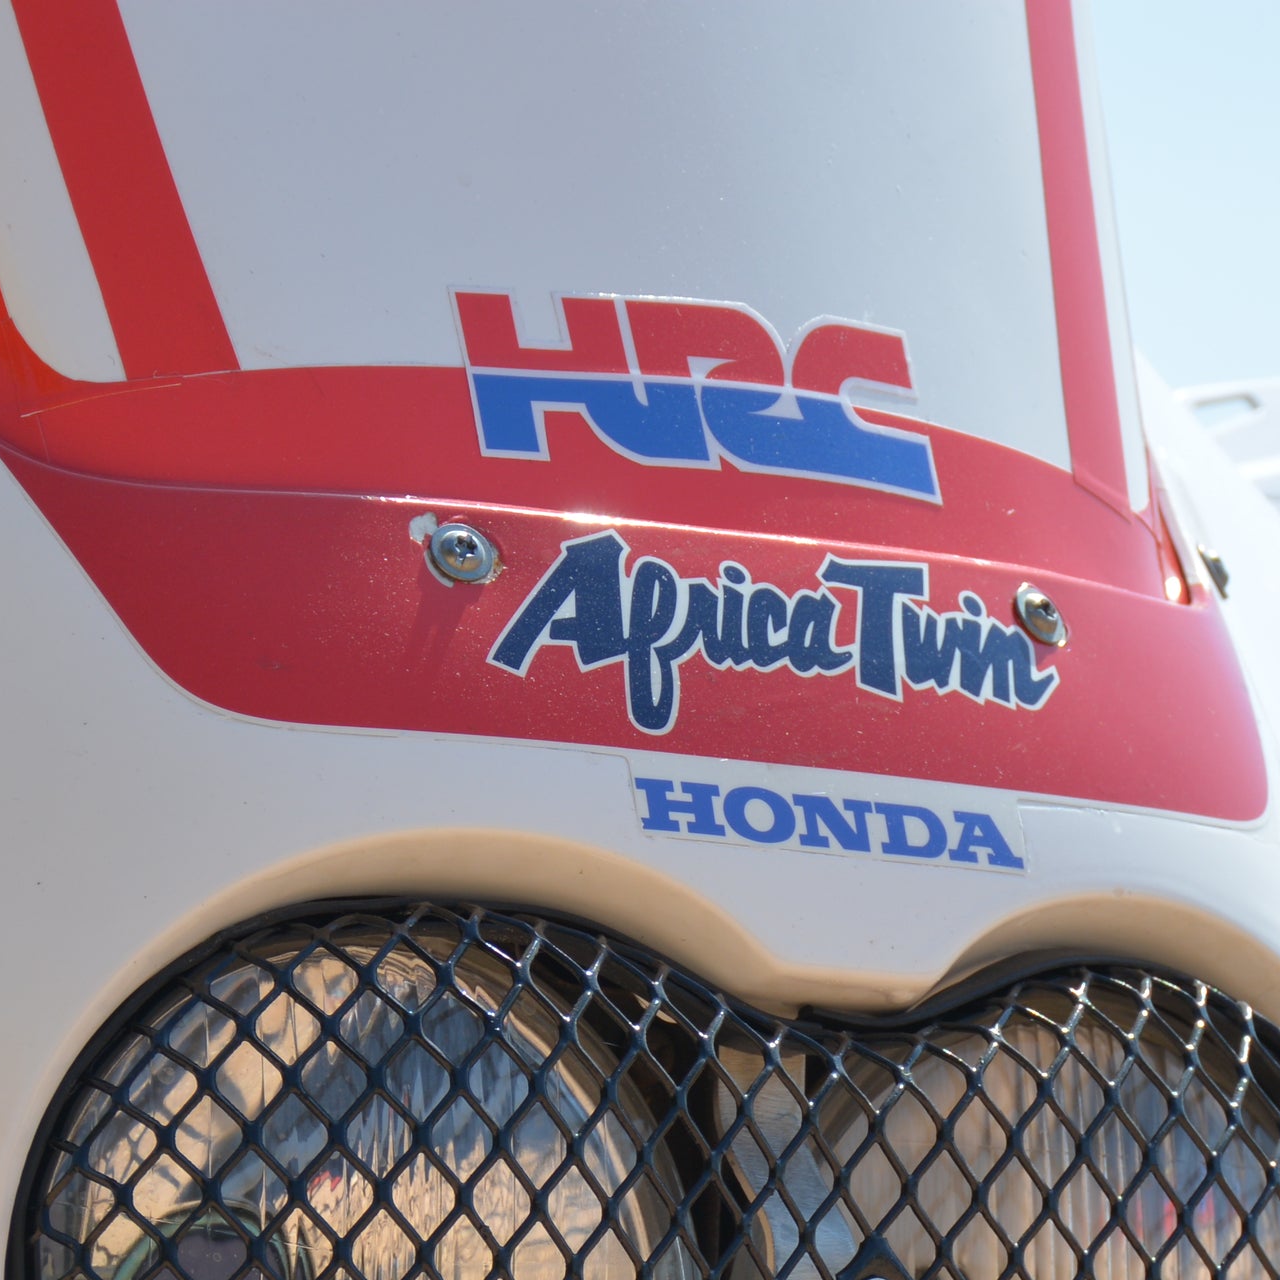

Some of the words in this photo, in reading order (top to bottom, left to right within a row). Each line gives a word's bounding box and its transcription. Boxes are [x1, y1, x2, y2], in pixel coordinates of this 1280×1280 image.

[452, 288, 939, 501] HRC
[488, 531, 854, 732] Africa
[818, 555, 1058, 708] Twin
[634, 776, 1025, 870] HONDA
